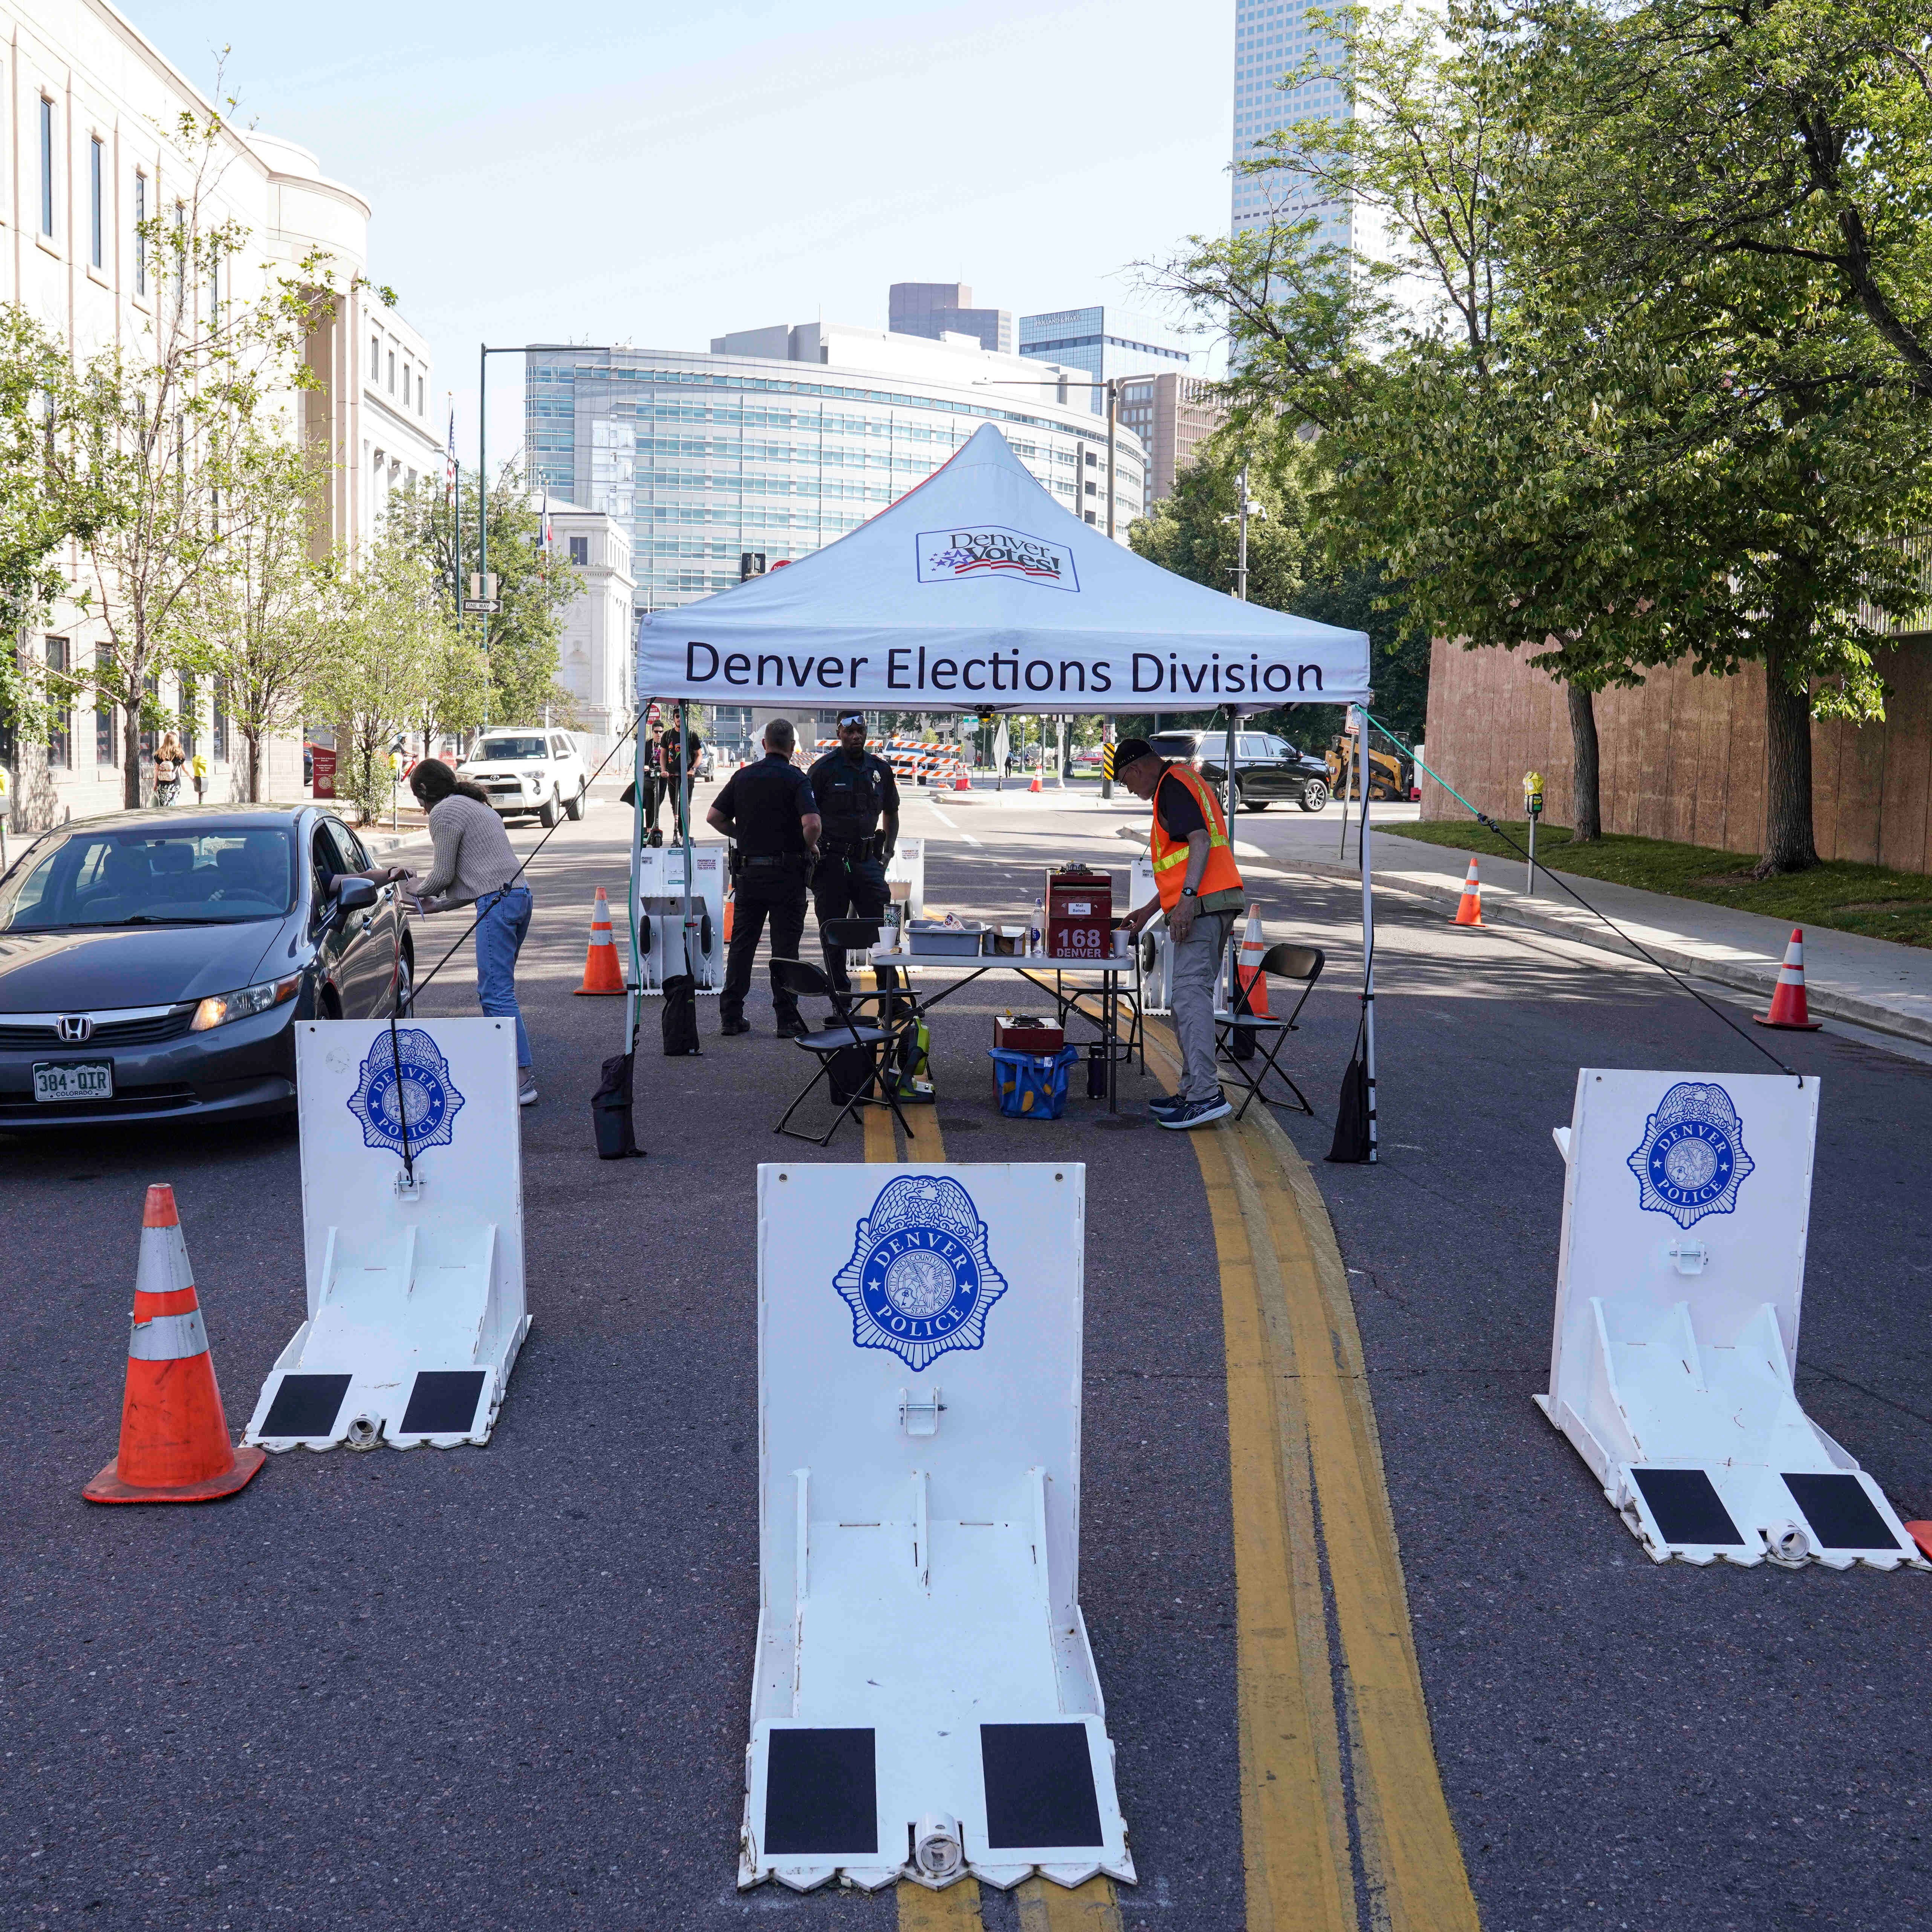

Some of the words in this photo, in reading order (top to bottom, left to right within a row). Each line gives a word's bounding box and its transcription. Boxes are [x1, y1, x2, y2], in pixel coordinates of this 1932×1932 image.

[948, 533, 1050, 558] Denver
[963, 546, 1062, 575] Votes!
[686, 642, 868, 688] Denver
[887, 646, 1112, 692] Elections
[1132, 652, 1323, 693] Division
[1058, 929, 1101, 947] 168
[1057, 948, 1101, 958] DENVER
[1658, 1124, 1726, 1154] DENVER
[1702, 1160, 1713, 1181] DENVER
[1657, 1178, 1722, 1203] POLICE
[873, 1232, 967, 1270] DENVER
[909, 1254, 939, 1263] COUNTY
[895, 1260, 907, 1274] AND
[941, 1268, 950, 1277] OF
[936, 1280, 951, 1307] DENVER
[875, 1303, 964, 1337] POLICE
